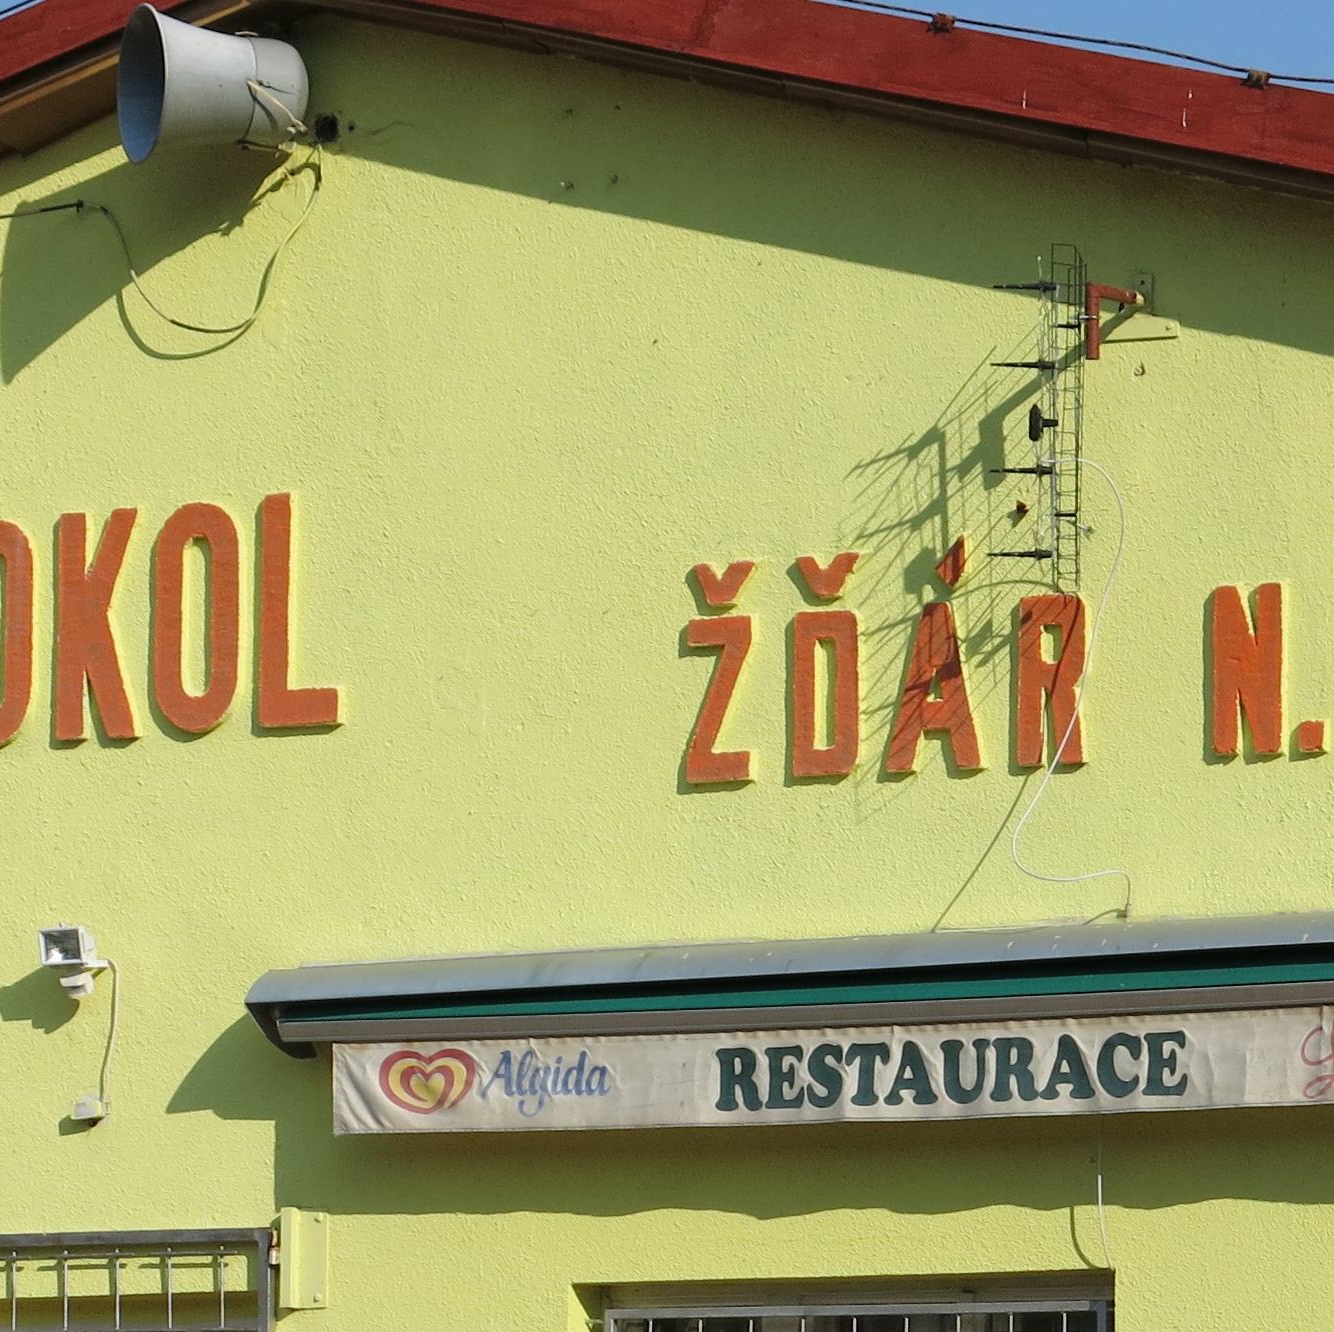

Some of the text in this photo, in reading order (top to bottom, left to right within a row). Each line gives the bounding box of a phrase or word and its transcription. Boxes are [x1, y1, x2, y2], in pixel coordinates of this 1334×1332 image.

[680, 534, 1089, 784] ŽĎÁR
[1205, 581, 1328, 759] N.
[480, 1049, 612, 1118] Algida
[714, 1030, 1189, 1112] RESTAURACE
